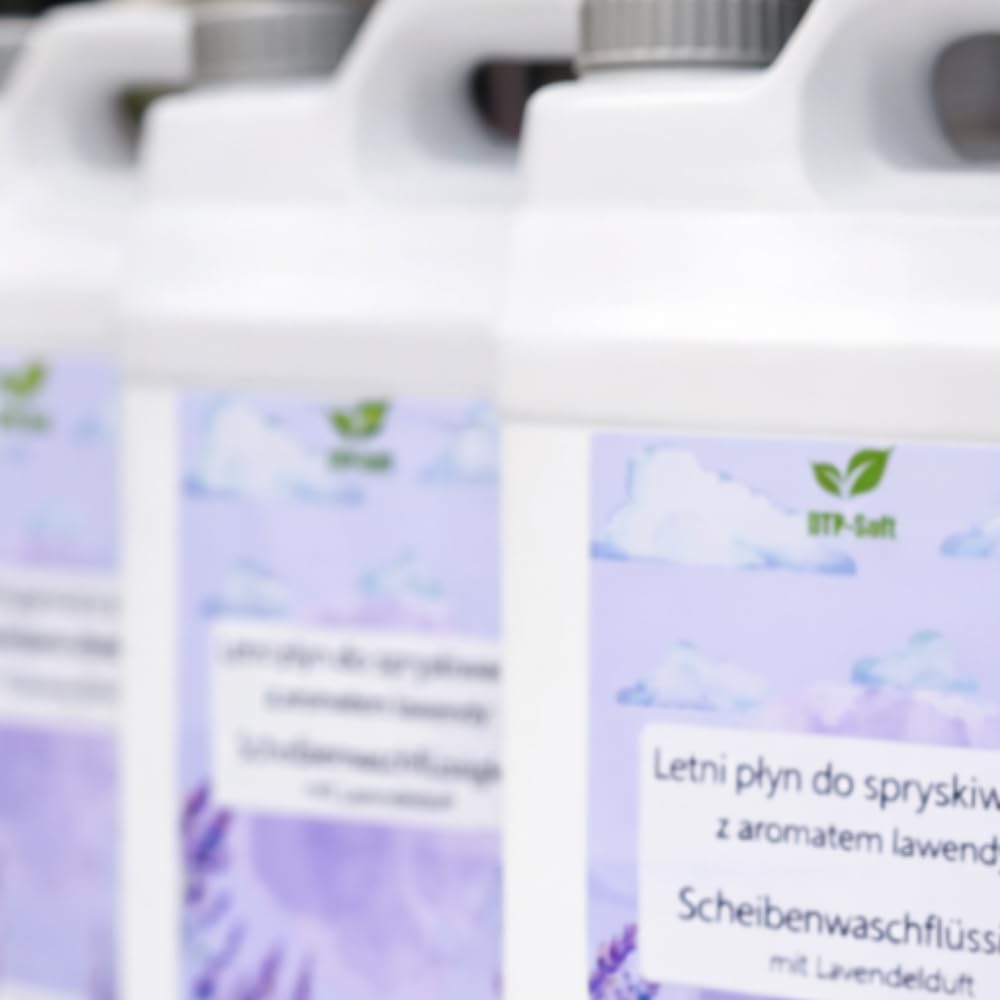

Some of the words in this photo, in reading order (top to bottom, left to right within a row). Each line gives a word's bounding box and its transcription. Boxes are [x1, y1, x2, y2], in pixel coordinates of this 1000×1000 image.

[653, 747, 727, 784] Letni
[735, 755, 802, 799] płyn
[811, 761, 855, 798] do
[715, 816, 730, 842] z
[737, 818, 883, 855] aromatem
[768, 953, 808, 979] mit
[815, 956, 977, 999] Lavendelduft
